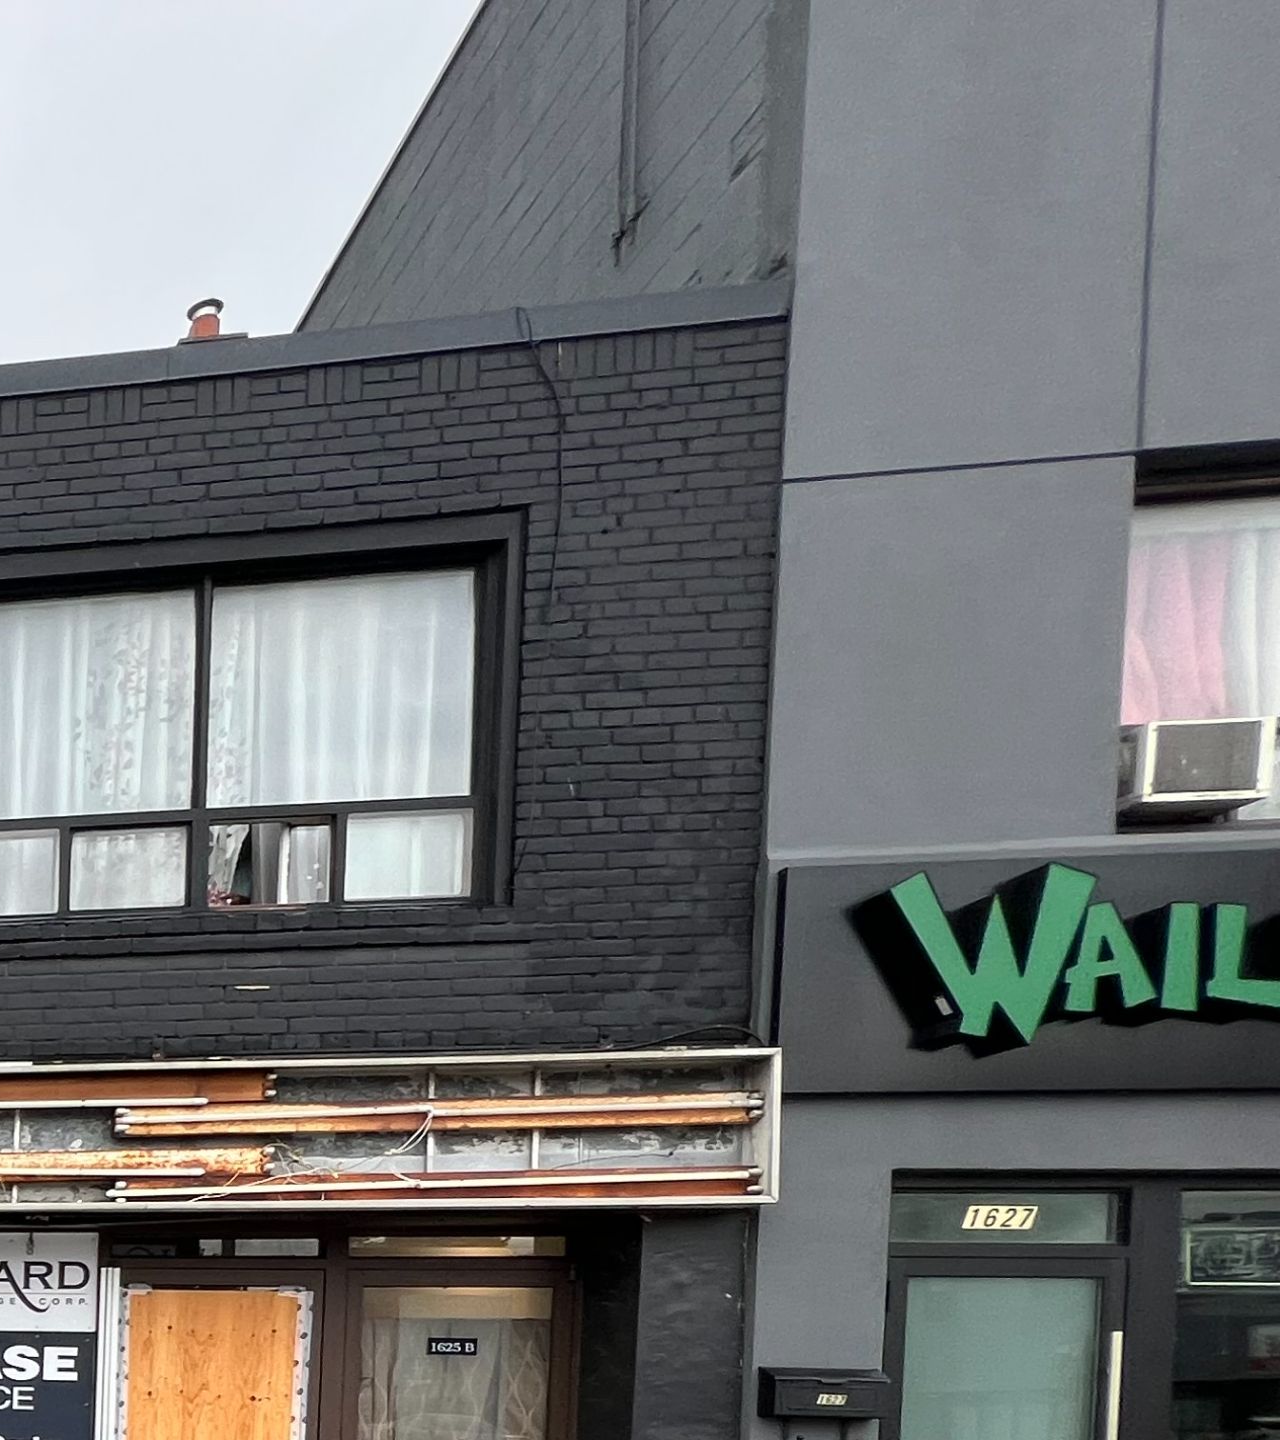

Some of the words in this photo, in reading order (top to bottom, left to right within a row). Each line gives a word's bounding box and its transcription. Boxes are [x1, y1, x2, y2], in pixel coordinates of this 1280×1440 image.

[891, 862, 1280, 1044] WAIL
[970, 1208, 1034, 1227] 1627
[38, 1298, 89, 1306] CORP.
[431, 1342, 461, 1353] 1625
[465, 1342, 475, 1353] B
